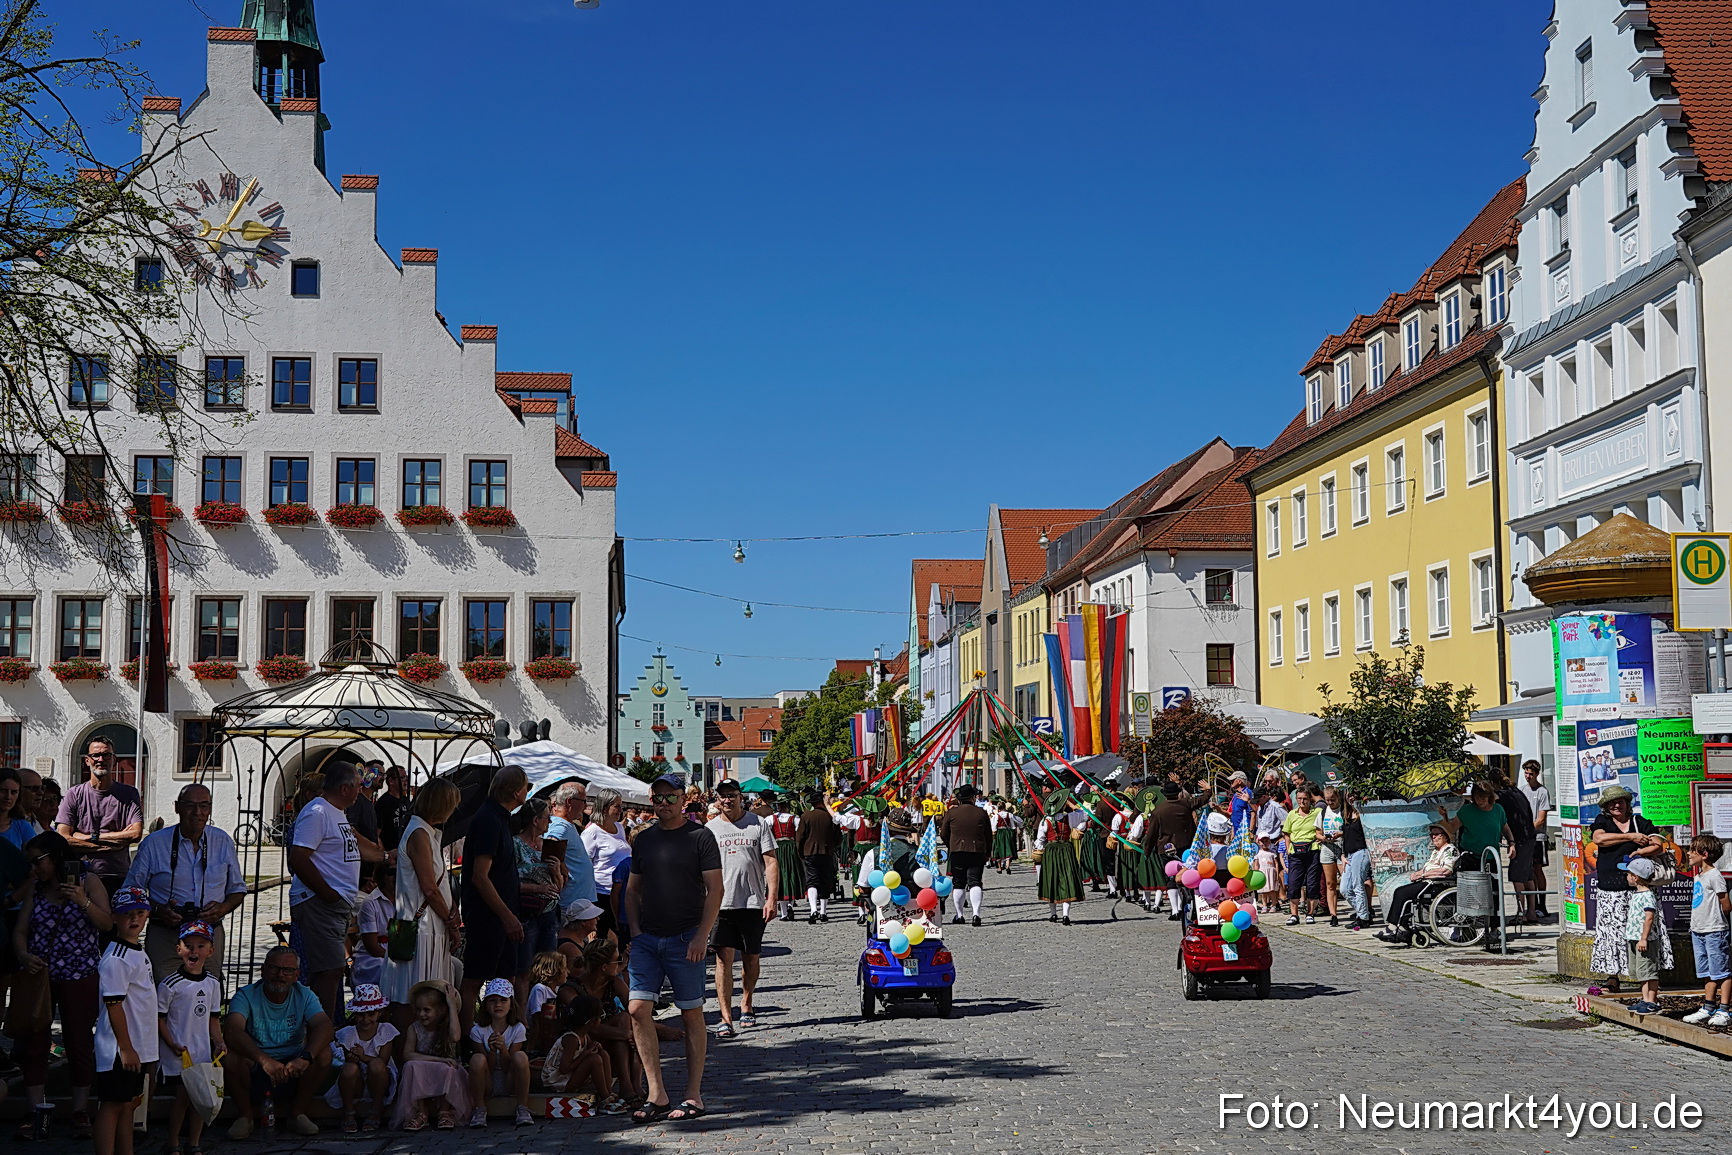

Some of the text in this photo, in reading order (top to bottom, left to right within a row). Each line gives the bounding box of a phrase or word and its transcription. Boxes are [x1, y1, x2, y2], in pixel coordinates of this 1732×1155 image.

[1564, 432, 1646, 484] BRILLEN WEBER
[1693, 550, 1713, 575] H
[1563, 631, 1579, 643] Park
[1658, 741, 1691, 751] JURA-
[1640, 753, 1703, 763] VOLKSFEST
[1666, 763, 1703, 772] 19.08.2024
[733, 838, 758, 847] CLUB
